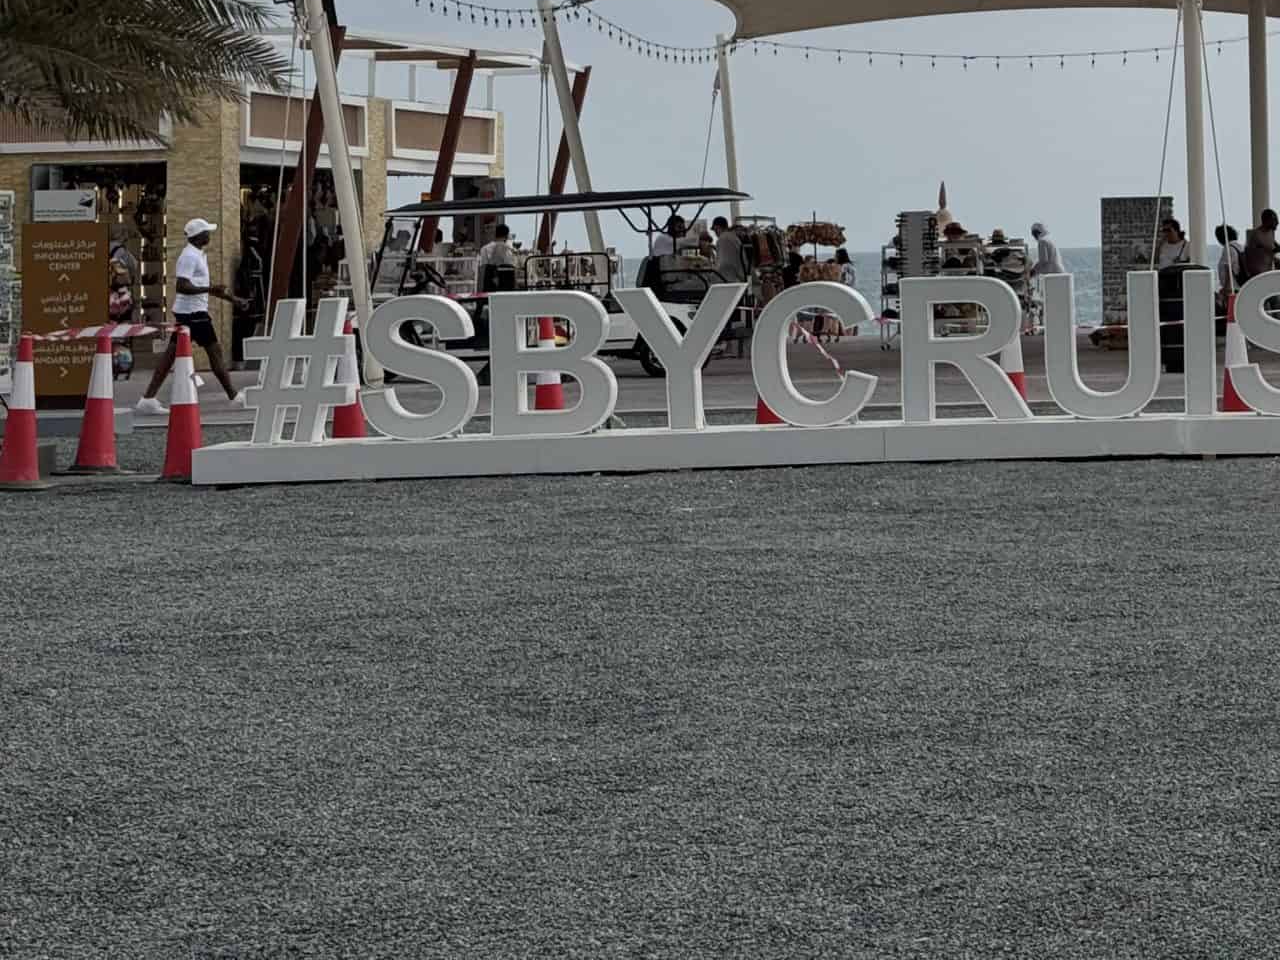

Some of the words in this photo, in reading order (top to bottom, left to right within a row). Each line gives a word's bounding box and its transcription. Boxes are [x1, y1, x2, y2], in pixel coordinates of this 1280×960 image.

[33, 251, 95, 261] INFORMATION
[48, 262, 81, 271] CENTER
[43, 304, 67, 313] MAIN
